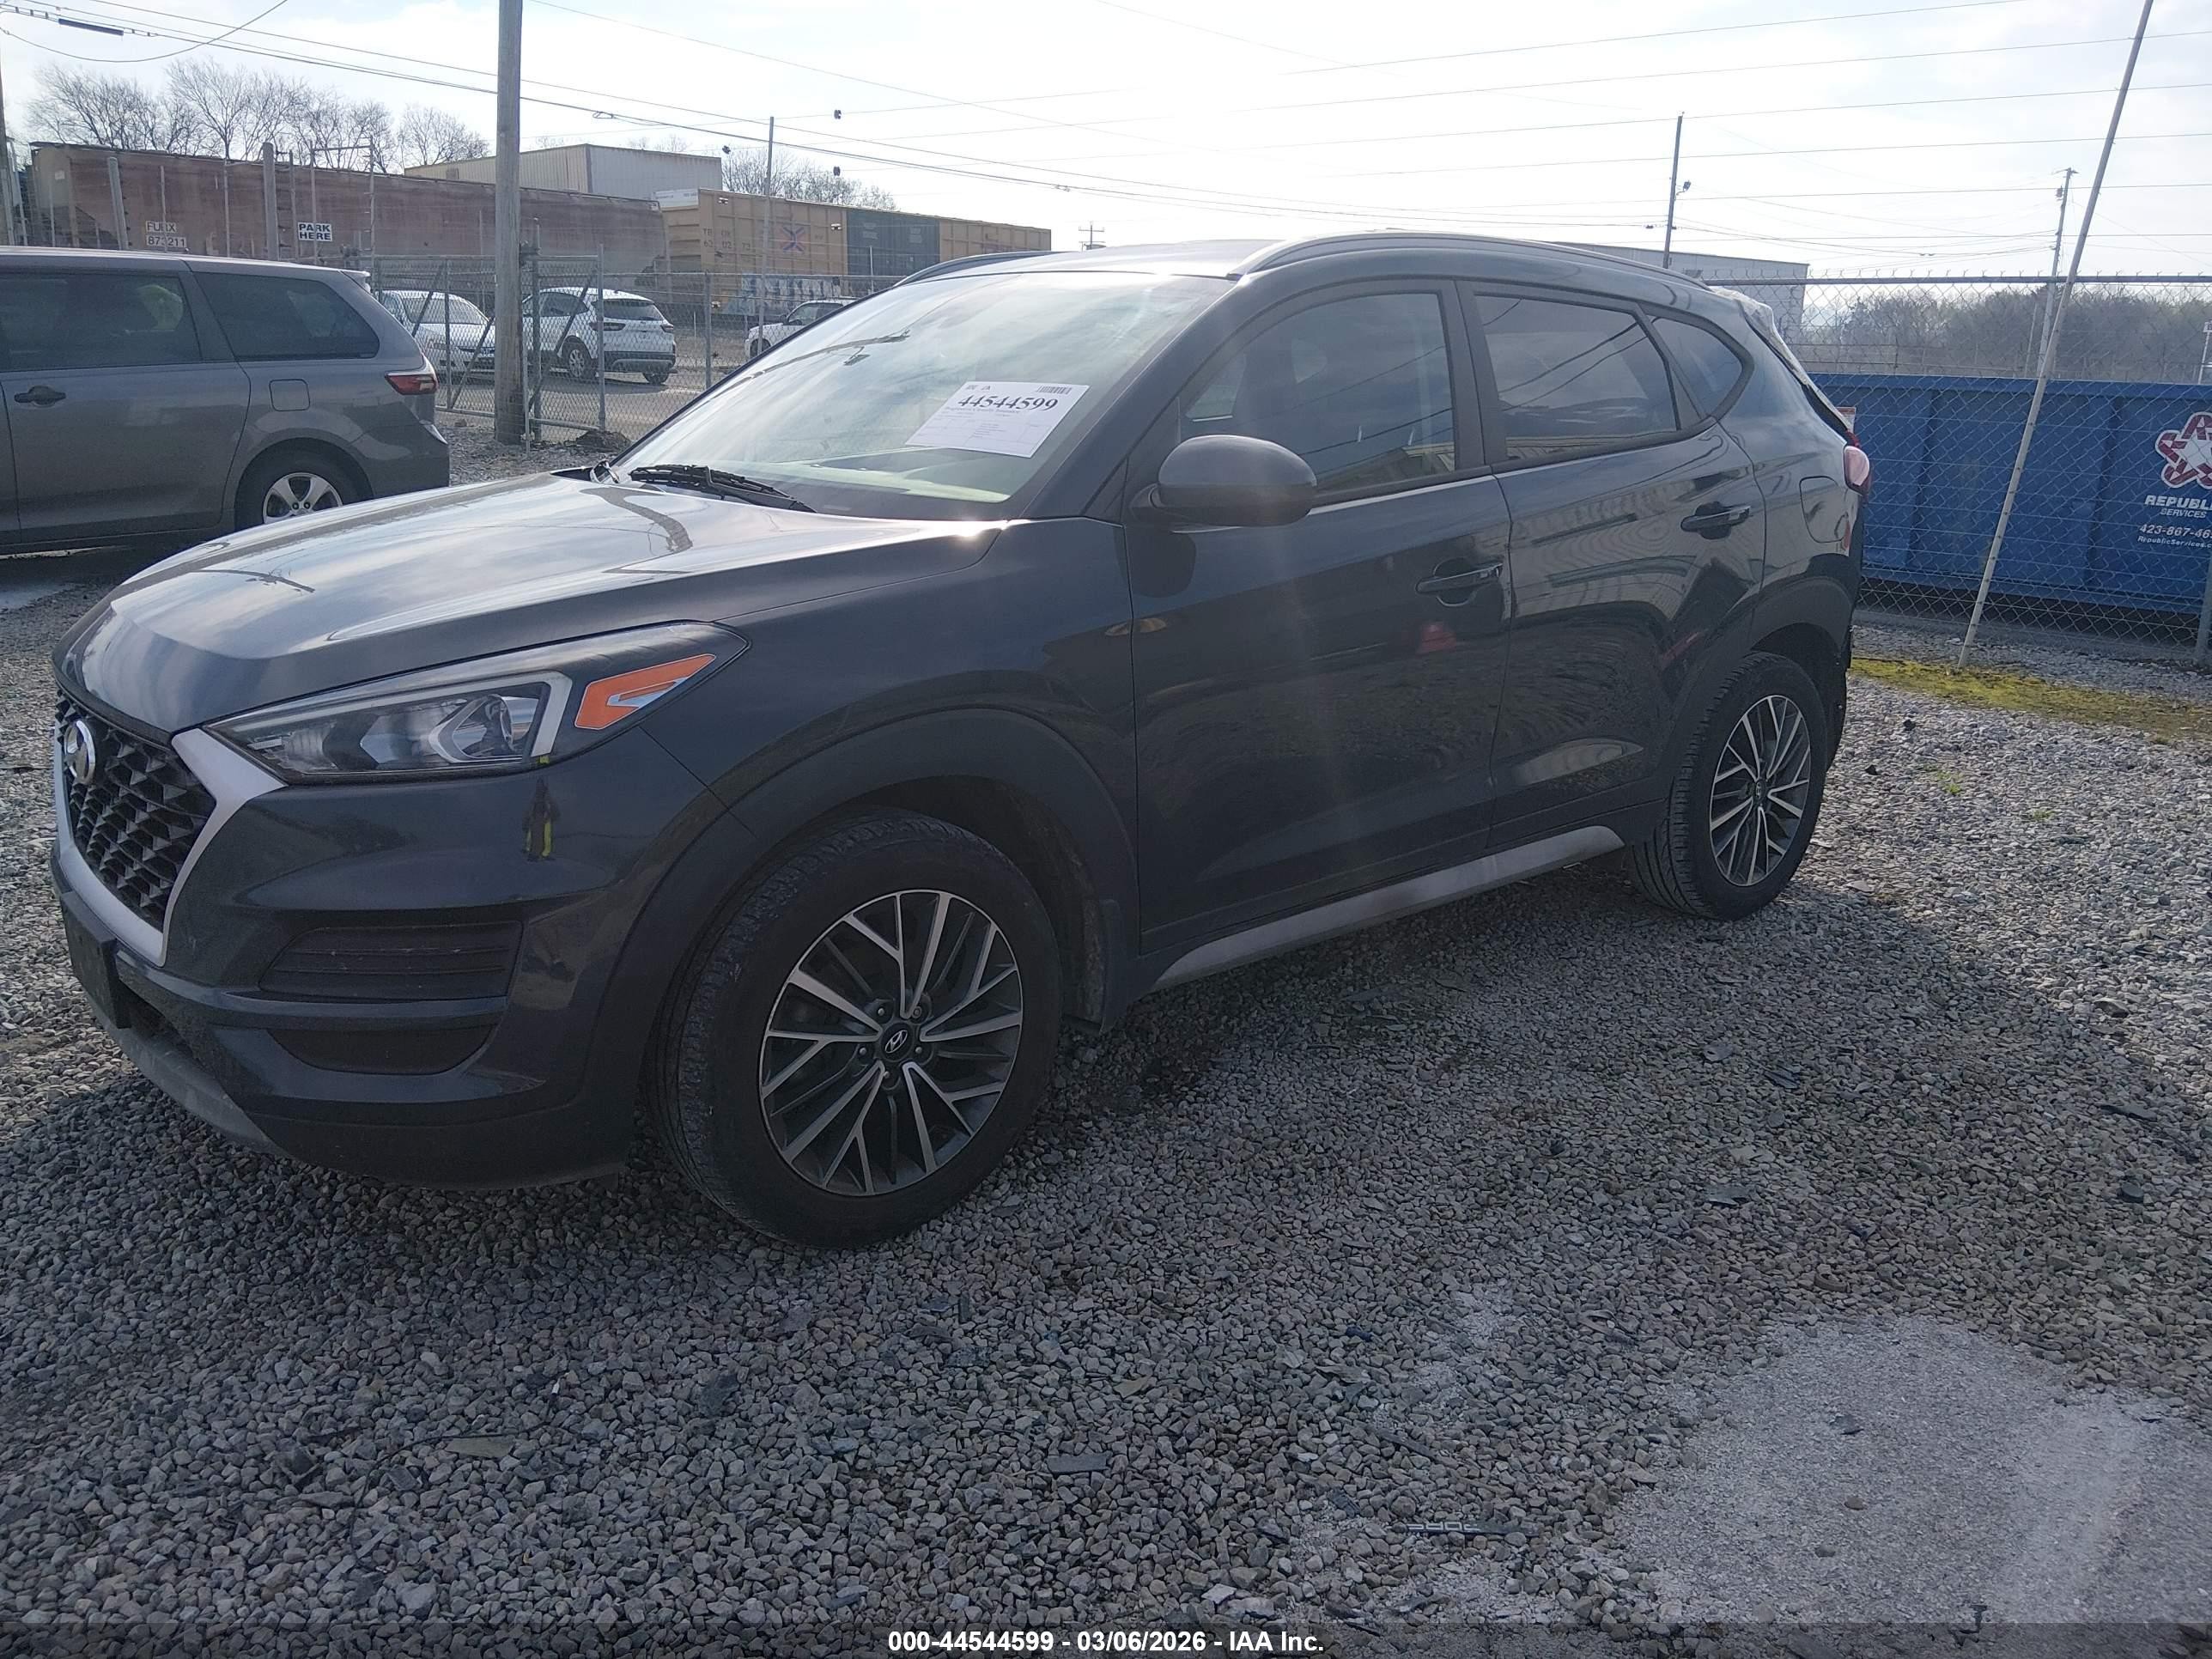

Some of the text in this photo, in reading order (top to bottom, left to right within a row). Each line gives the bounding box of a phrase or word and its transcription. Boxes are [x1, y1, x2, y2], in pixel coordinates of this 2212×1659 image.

[299, 223, 331, 232] PARK
[300, 232, 331, 240] HERE
[957, 394, 1059, 411] 44544599
[2144, 495, 2212, 510] REPUBL
[2160, 507, 2208, 519] SERVICES
[2139, 524, 2212, 539] 423-867-46
